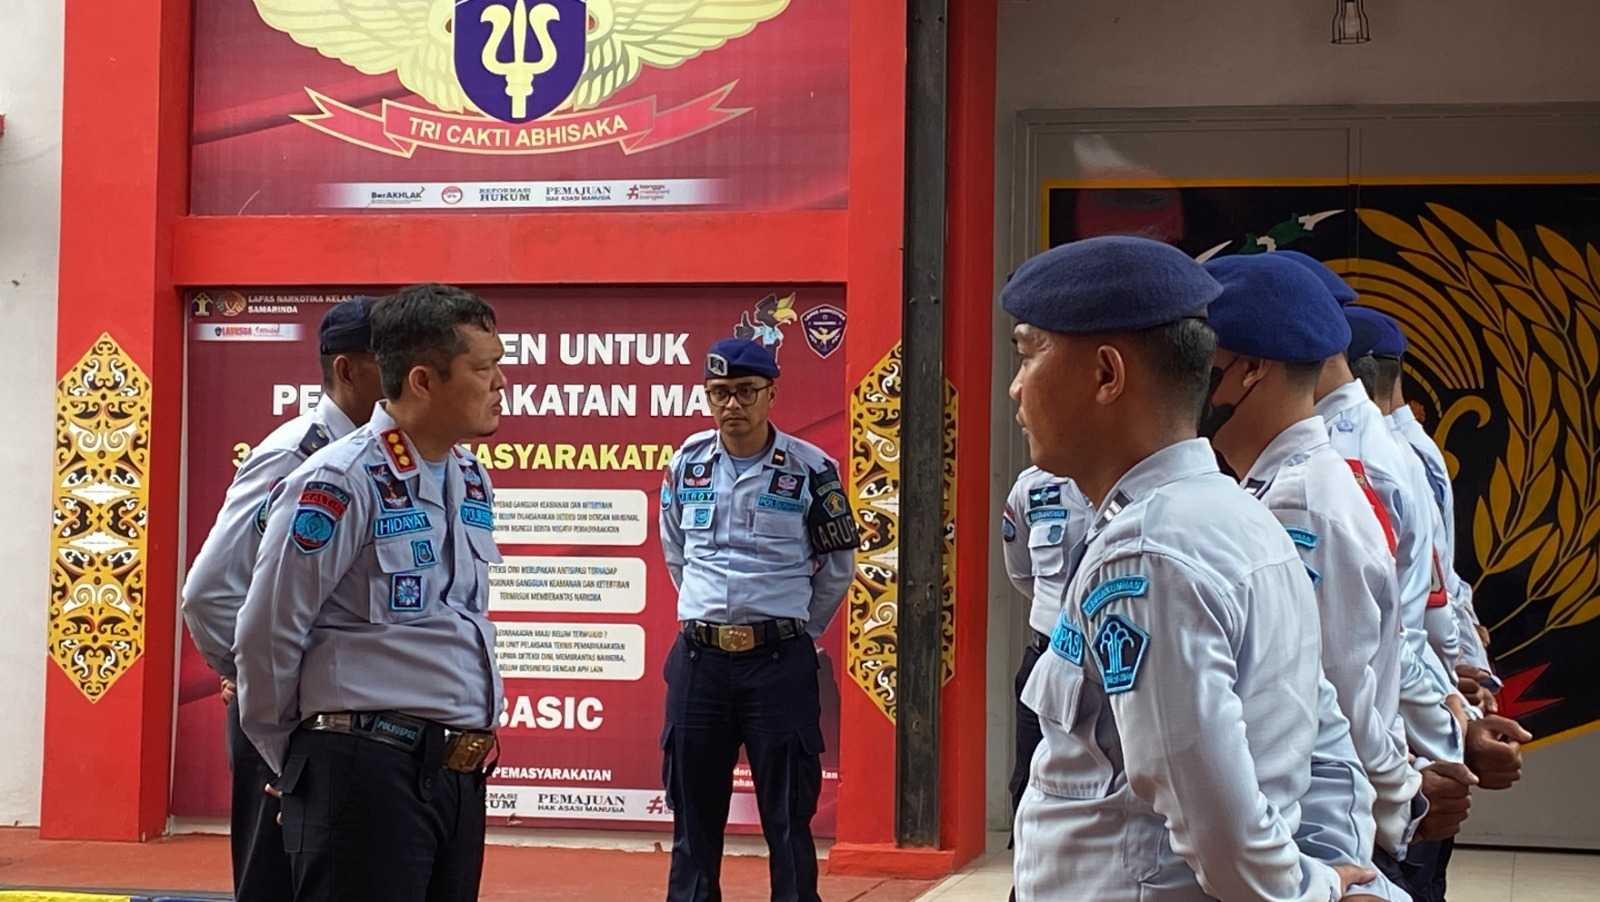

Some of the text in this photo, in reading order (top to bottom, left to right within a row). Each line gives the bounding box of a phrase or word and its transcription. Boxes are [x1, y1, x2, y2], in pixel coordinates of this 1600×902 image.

[409, 114, 628, 147] TRI CAKTI ABHISAKA
[546, 186, 612, 195] PEMAJUAN
[480, 194, 530, 202] HUKUM
[248, 295, 275, 303] LAPAS
[277, 295, 323, 303] NARKOTIKA
[325, 295, 352, 303] KELAS
[248, 305, 298, 314] SAMARINDA
[559, 333, 691, 366] UNTUK
[465, 442, 674, 471] ASYARAKATA
[379, 514, 426, 535] HIDAYAT
[491, 766, 612, 782] PEMASYARAKATAN
[538, 793, 626, 806] PEMAJUAN
[538, 804, 556, 812] HAK
